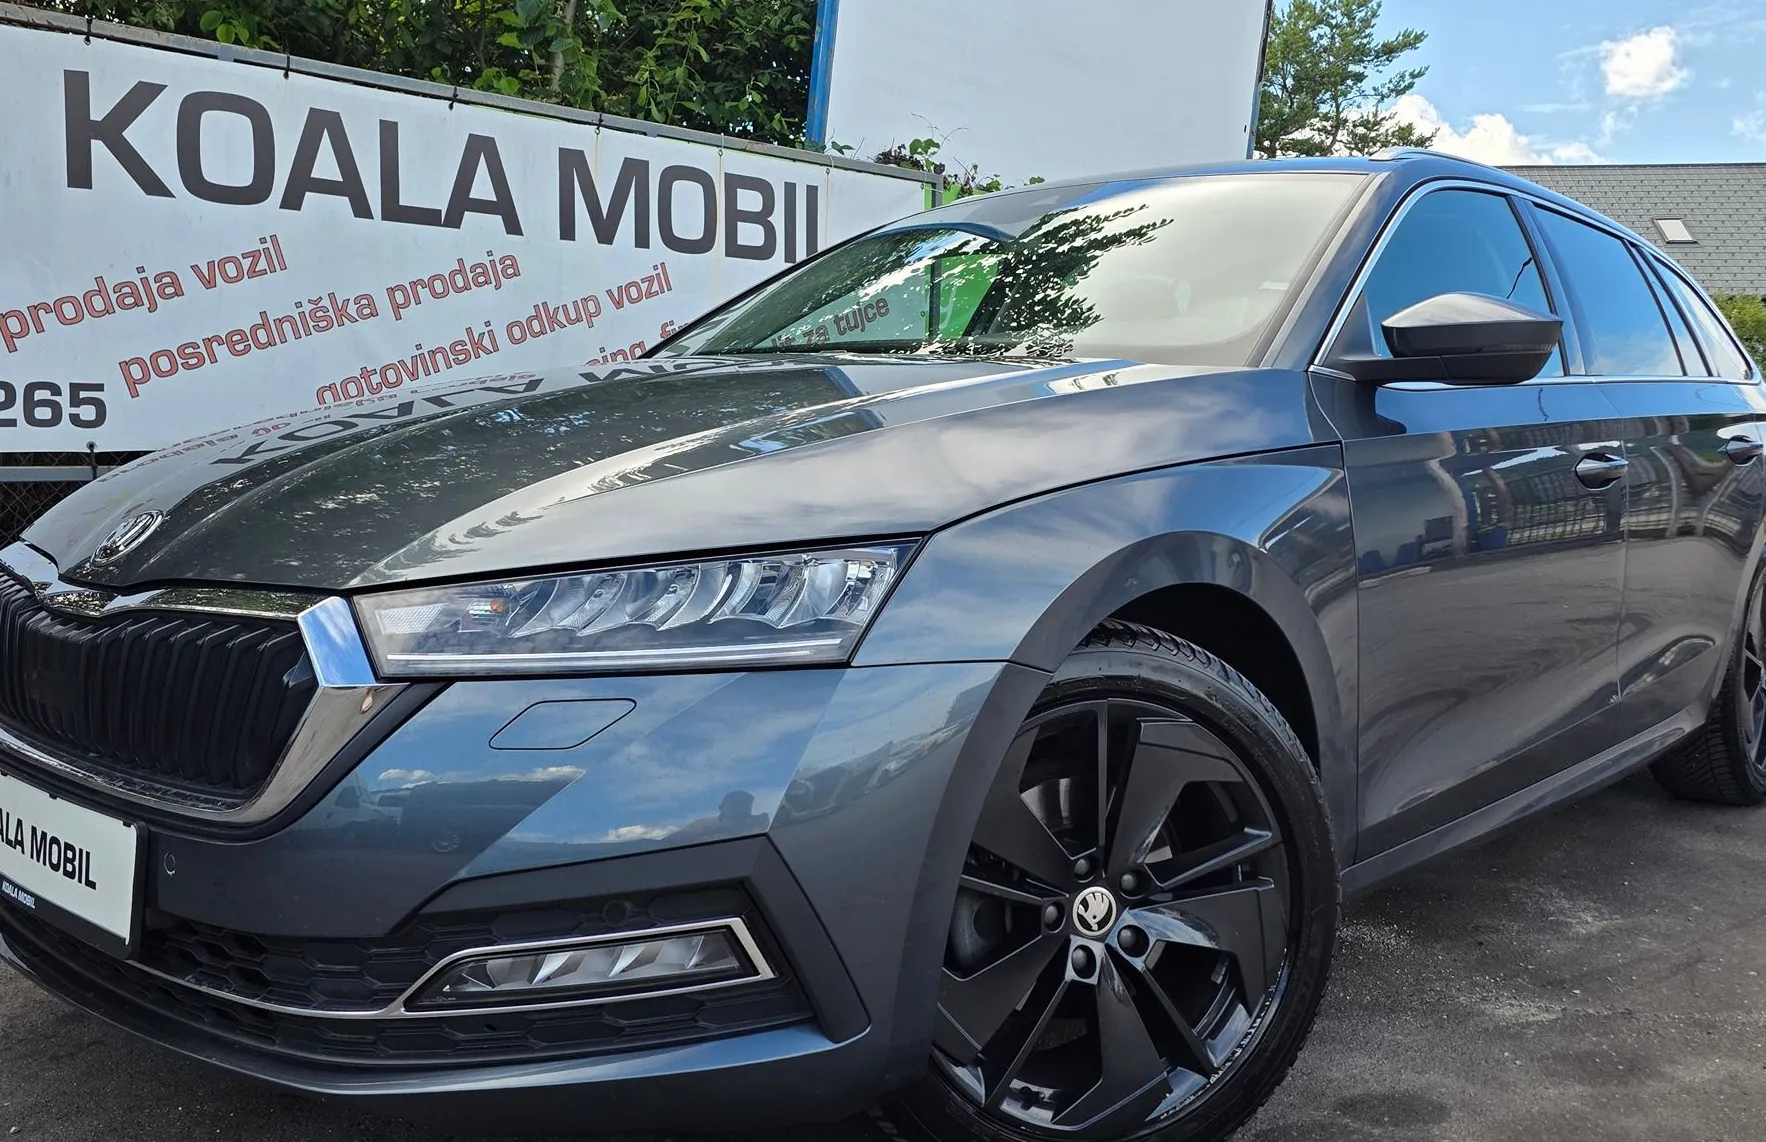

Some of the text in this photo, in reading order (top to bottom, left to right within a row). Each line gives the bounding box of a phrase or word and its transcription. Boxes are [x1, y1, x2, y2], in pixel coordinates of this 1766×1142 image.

[63, 69, 524, 237] KOALA
[0, 234, 288, 353] prodaja vozil
[118, 250, 522, 399] posredniška prodaja
[315, 262, 673, 406] gotovinski odkup vozil
[834, 297, 890, 337] tujce
[18, 890, 36, 909] MOBIL
[30, 825, 97, 891] MOBIL
